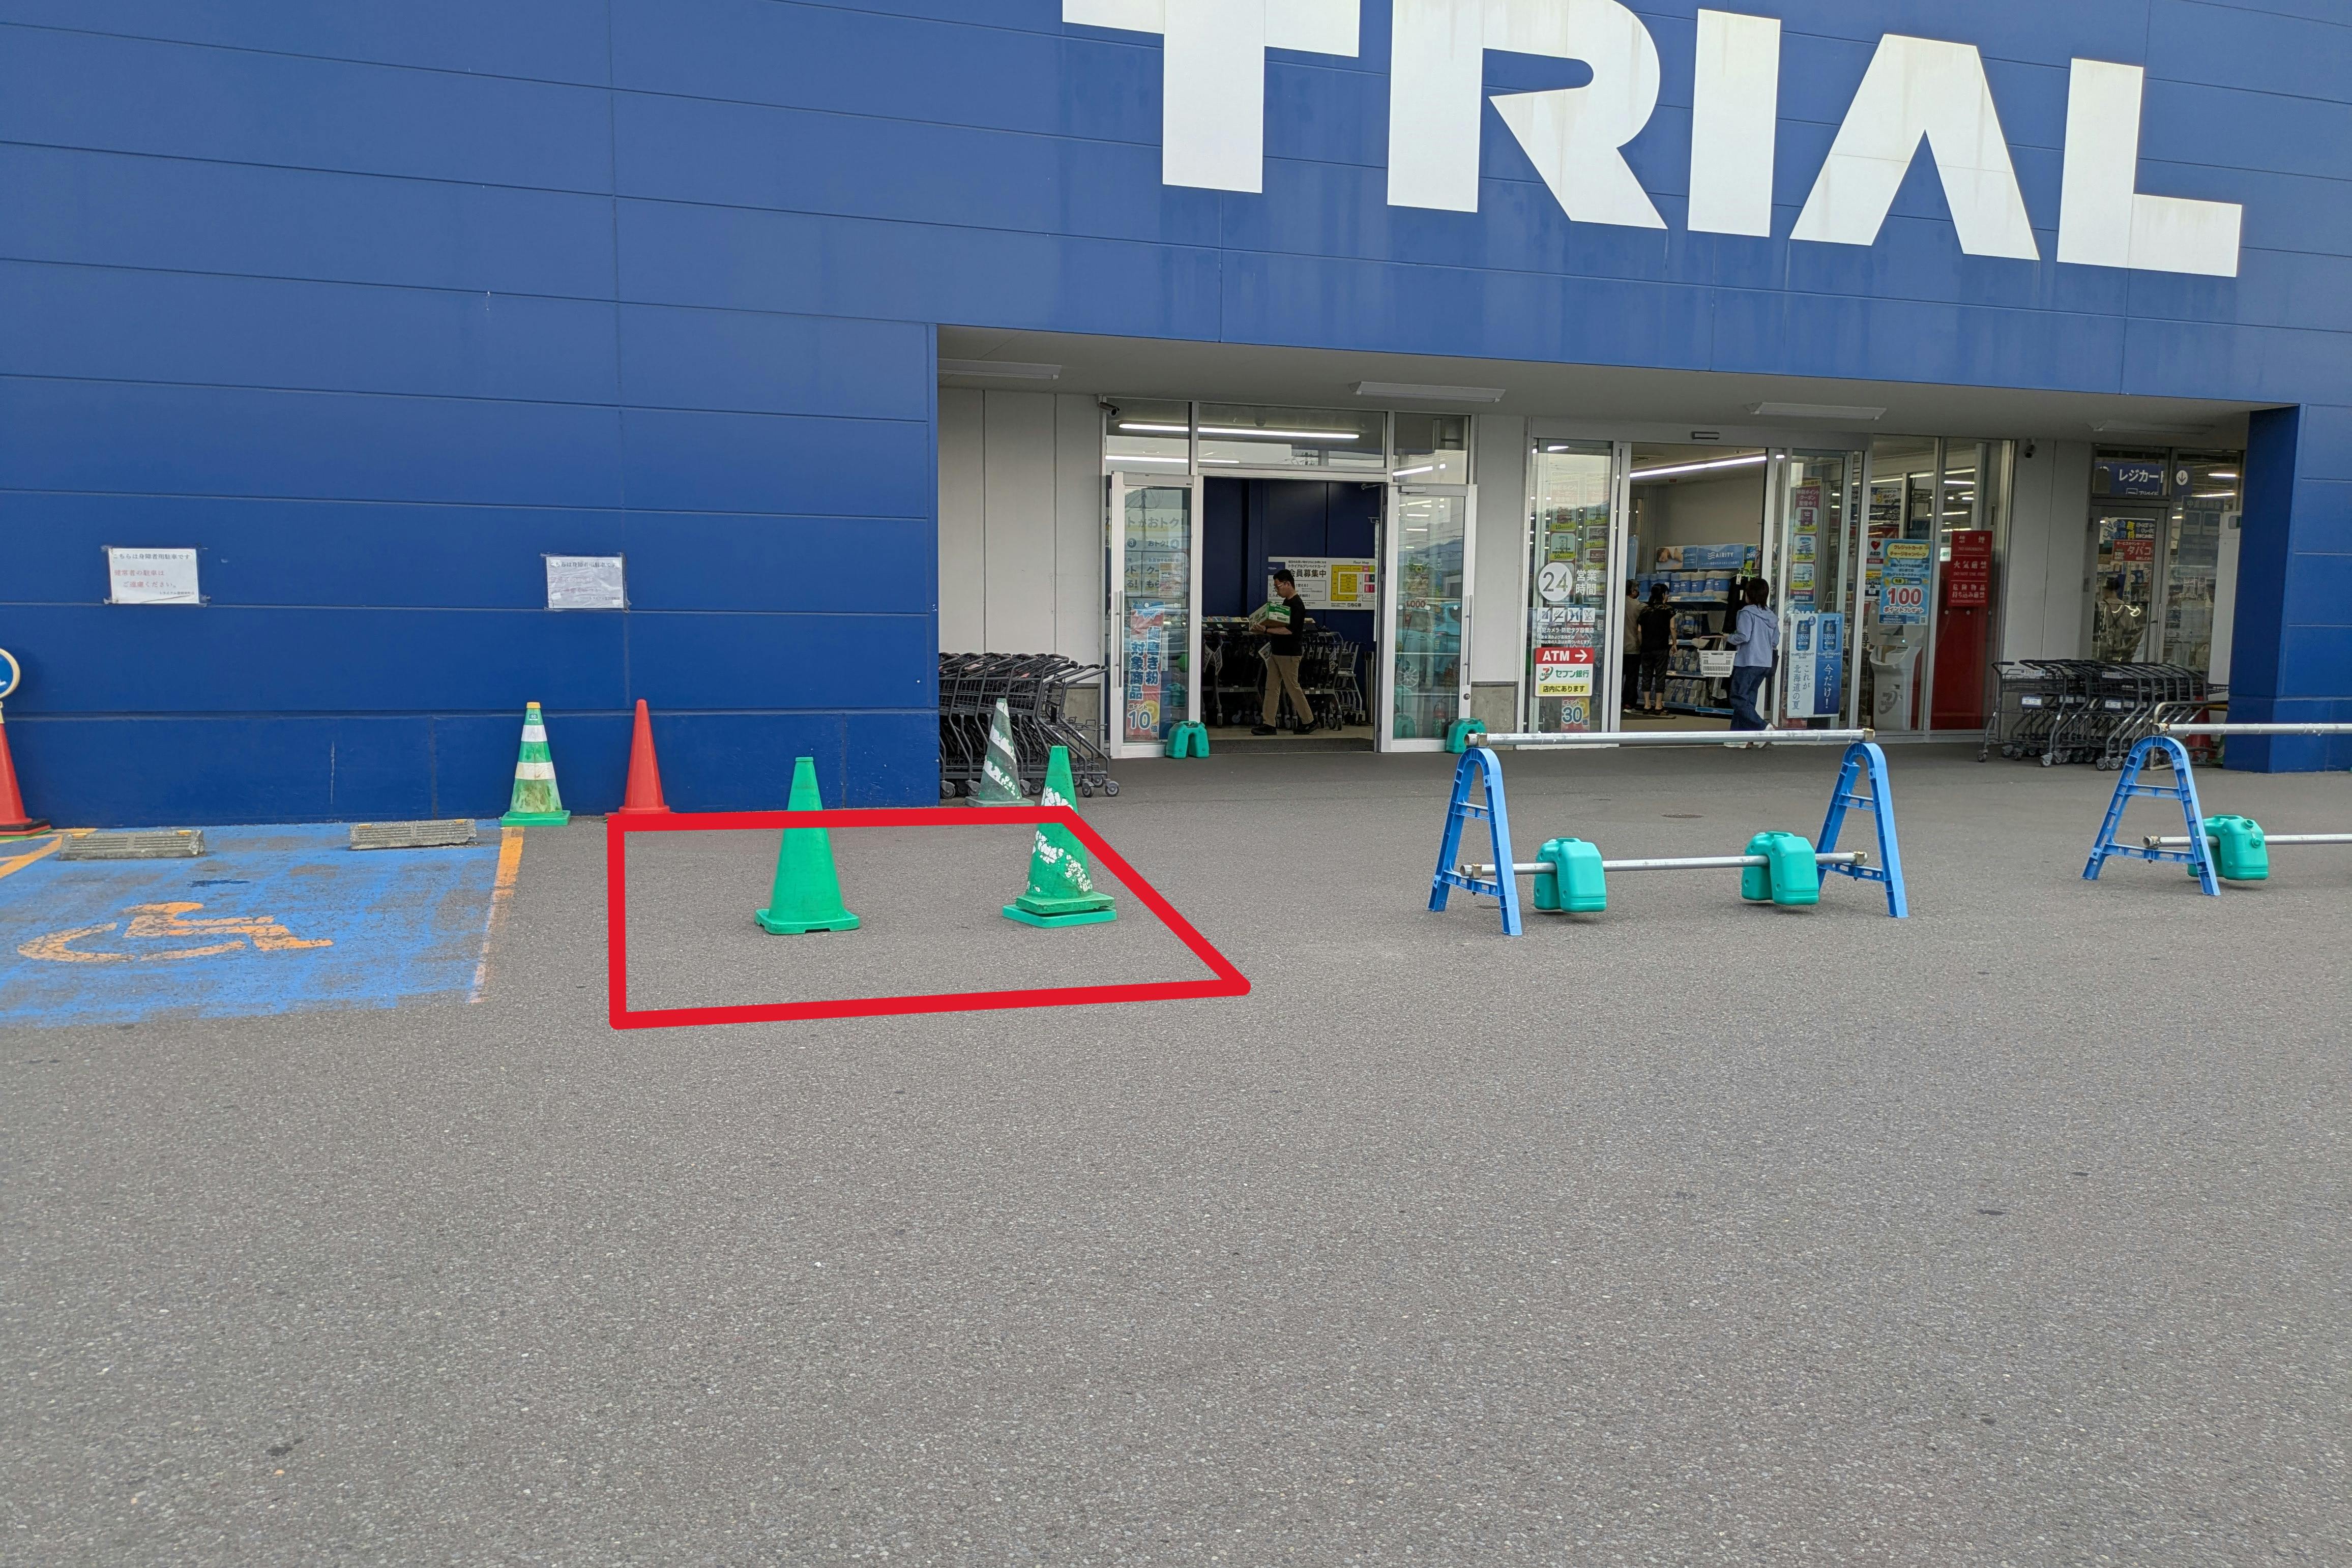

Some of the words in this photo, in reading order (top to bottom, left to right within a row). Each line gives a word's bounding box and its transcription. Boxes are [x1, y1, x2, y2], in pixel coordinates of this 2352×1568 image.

[1062, 0, 2242, 278] TRIAL
[1289, 569, 1327, 578] 会員募集中
[1543, 572, 1568, 592] 24
[1577, 570, 1597, 582] 営業
[1575, 584, 1596, 596] 時間
[1888, 587, 1922, 605] 100
[1542, 650, 1570, 661] ATM
[1129, 641, 1145, 700] 対象商品
[1555, 670, 1590, 678] セブン銀行
[1802, 665, 1811, 690] これが
[1792, 664, 1801, 710] 北海道の夏
[1823, 664, 1834, 708] 今だけ!
[1128, 711, 1152, 729] 10
[1562, 706, 1583, 723] 30
